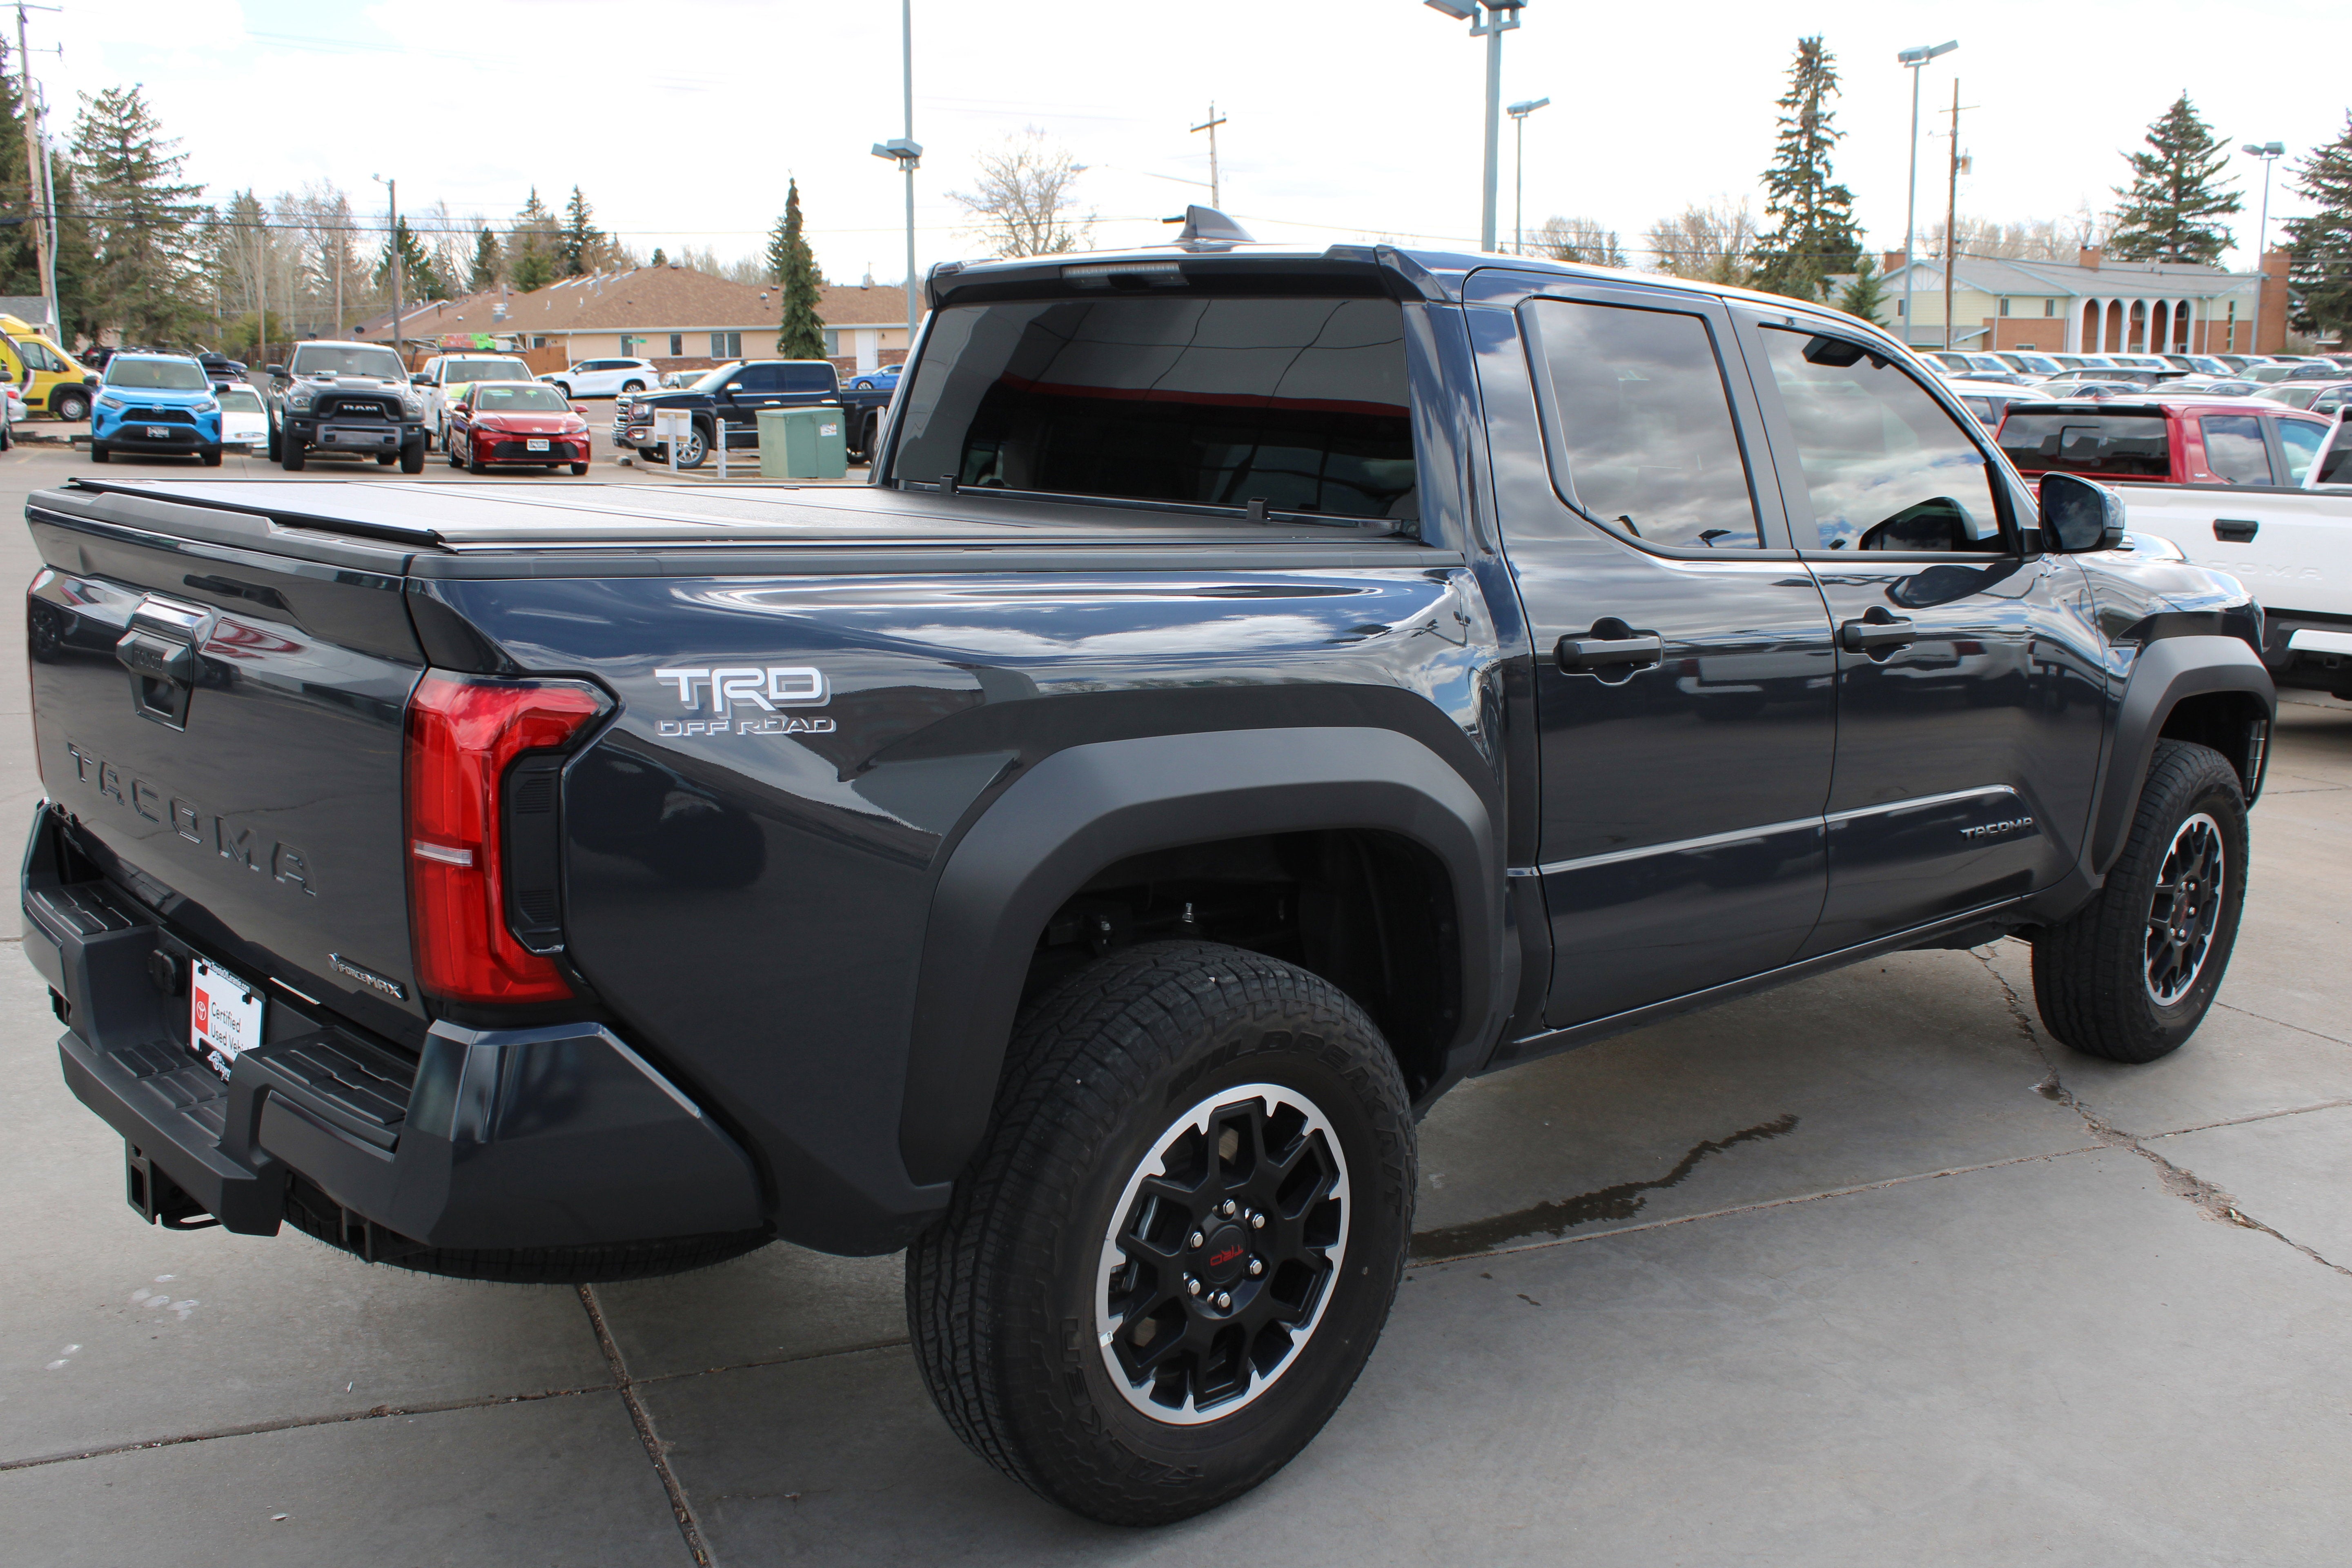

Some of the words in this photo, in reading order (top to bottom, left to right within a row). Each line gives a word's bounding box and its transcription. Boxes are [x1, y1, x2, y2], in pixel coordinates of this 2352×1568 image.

[342, 403, 378, 412] RAM
[2207, 560, 2324, 581] COMA
[654, 667, 831, 719] TRD
[655, 719, 730, 737] OFF
[735, 716, 837, 736] ROAD
[68, 741, 317, 897] TACOMA
[1959, 817, 2034, 841] TACOMA
[211, 1002, 241, 1033] Certified
[211, 1022, 227, 1047] Used
[1166, 1028, 1389, 1119] WILDPEAK
[1209, 1244, 1244, 1267] TRD
